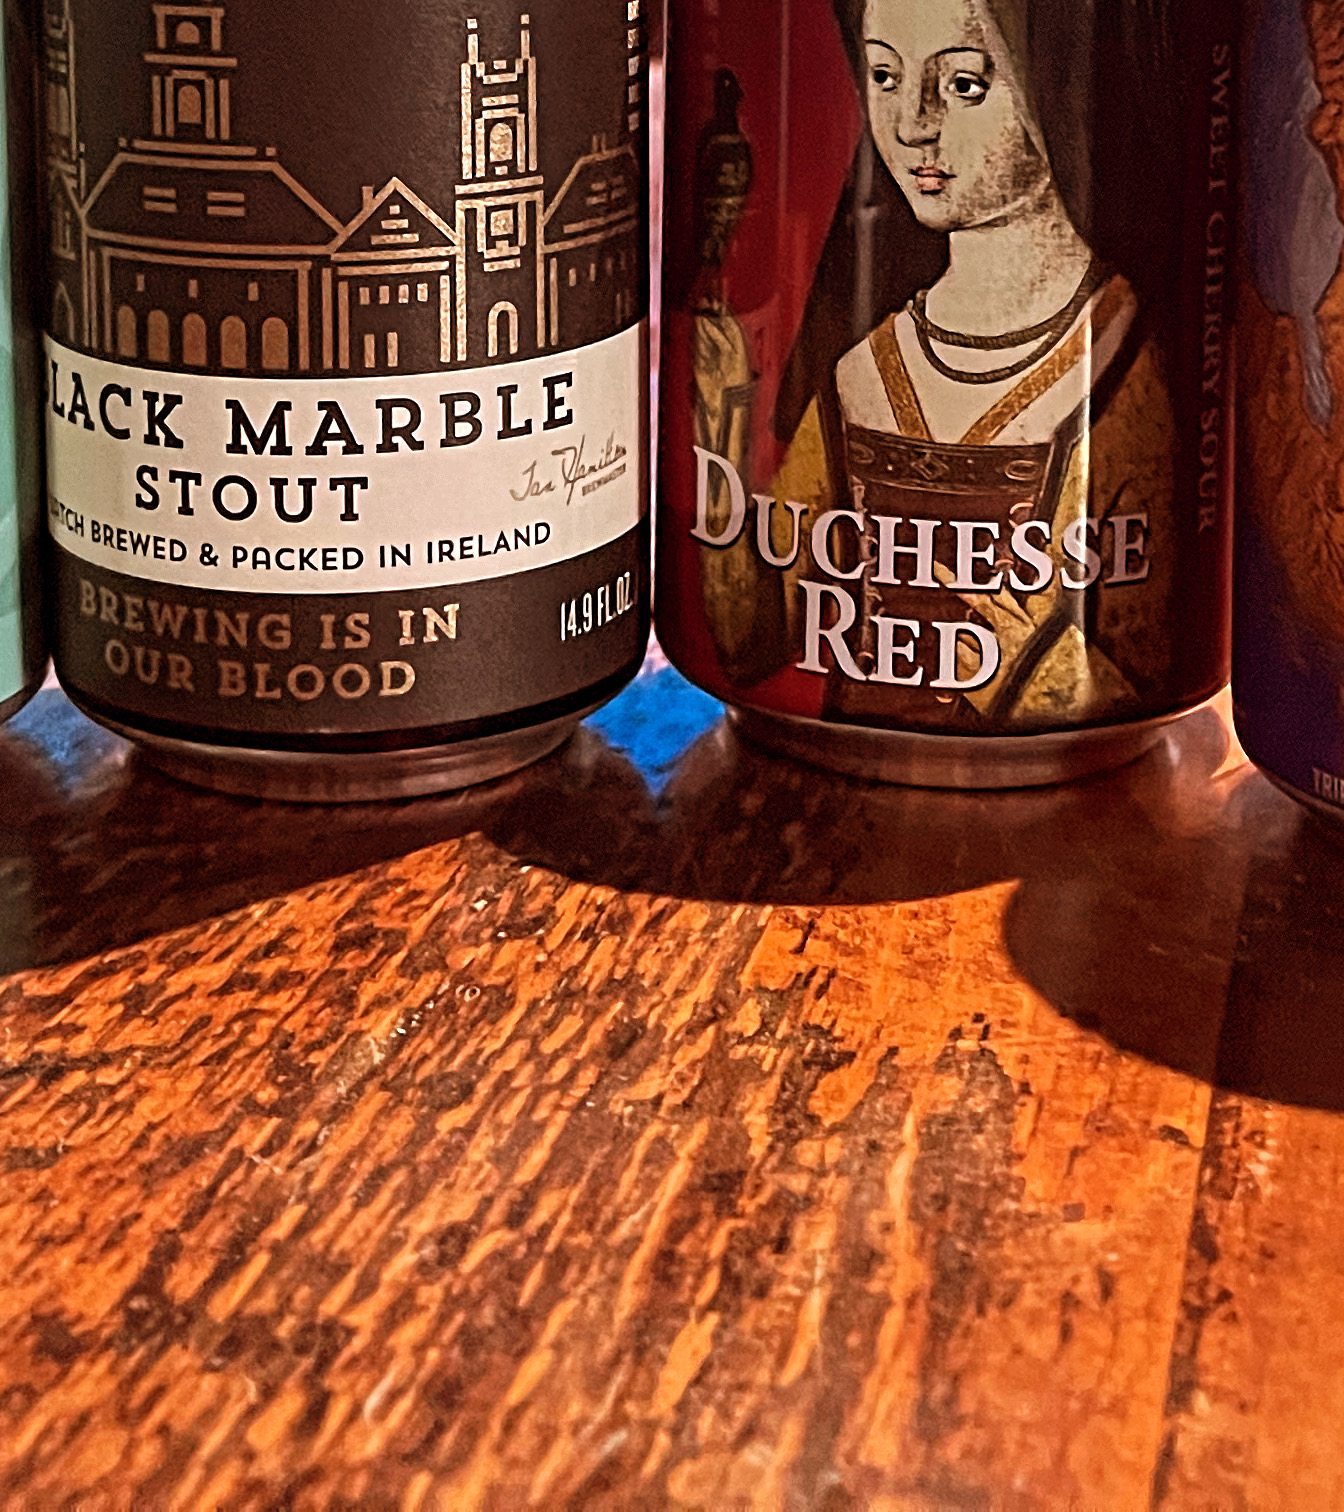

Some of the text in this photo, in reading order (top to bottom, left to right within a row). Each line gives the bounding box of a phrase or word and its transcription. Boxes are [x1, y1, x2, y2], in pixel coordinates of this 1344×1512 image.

[1197, 44, 1231, 533] SWEET CHERRY SOUR
[51, 359, 575, 457] LACK MARBLE
[135, 465, 369, 523] STOUT
[691, 447, 1149, 592] DUCHESSE
[91, 519, 187, 562] BREWED
[200, 544, 220, 569] &
[232, 545, 364, 572] PACKED
[379, 543, 412, 570] IN
[427, 522, 552, 565] IRELAND
[79, 578, 460, 651] BREWING IS IN
[560, 592, 593, 641] 14.9
[597, 584, 617, 627] FL
[796, 579, 1001, 691] RED
[104, 638, 417, 701] OUR BLOOD
